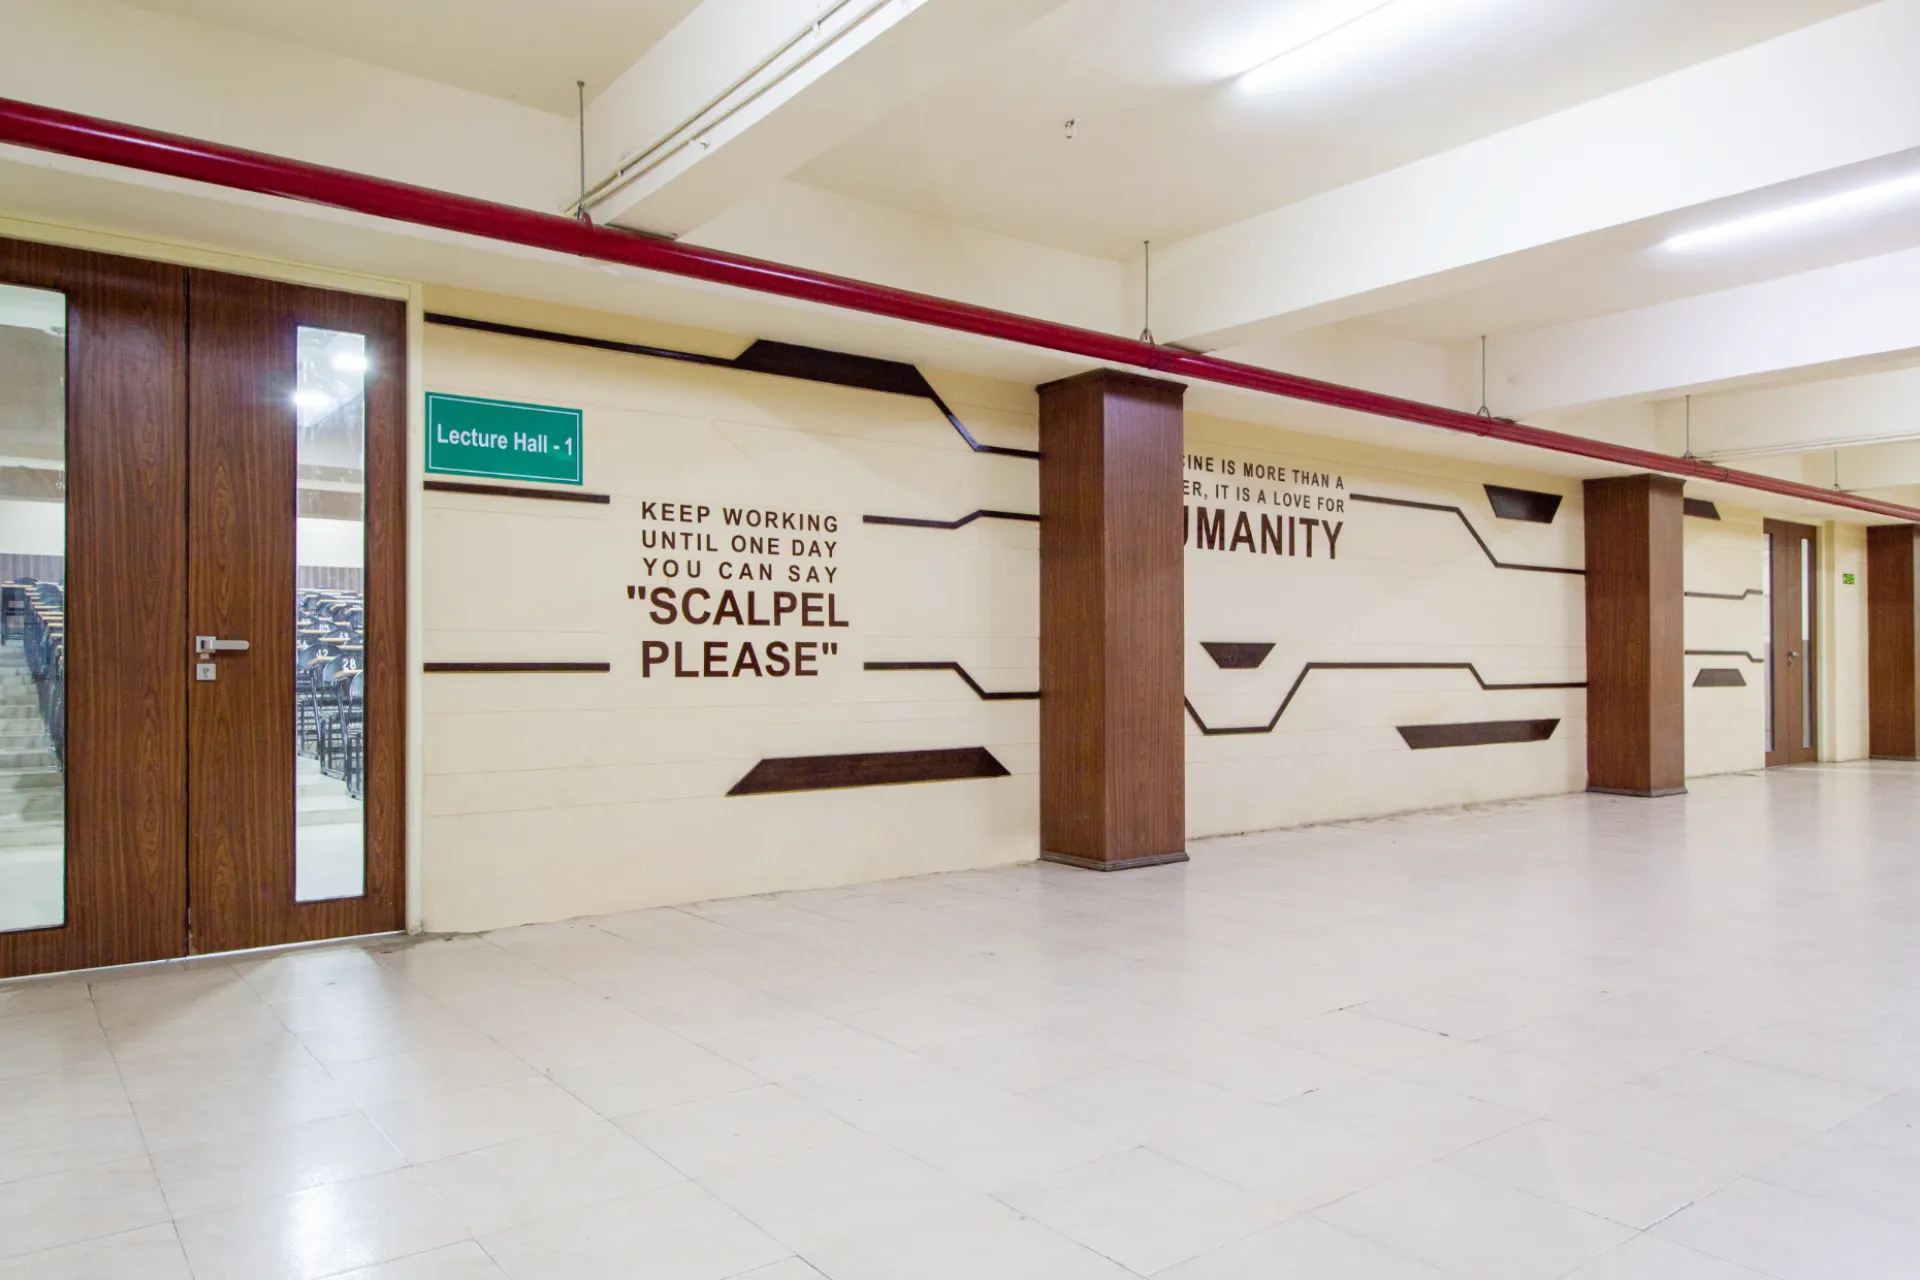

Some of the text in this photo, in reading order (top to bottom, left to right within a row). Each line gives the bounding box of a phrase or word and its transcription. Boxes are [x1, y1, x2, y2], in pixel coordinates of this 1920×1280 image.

[436, 423, 508, 450] Lecture
[513, 431, 548, 454] Hall
[564, 437, 573, 456] 1
[1221, 458, 1236, 476] IS
[1243, 462, 1286, 482] MORE
[1291, 468, 1330, 488] THAN
[1335, 475, 1345, 490] A
[1215, 483, 1229, 500] IT
[1236, 486, 1251, 503] IS
[1257, 489, 1267, 504] A
[1273, 490, 1311, 510] LOVE
[1317, 496, 1345, 514] FOR
[641, 501, 838, 533] KEEP WORKING
[642, 529, 837, 559] UNTIL ONE DAY
[642, 557, 837, 584] YOU CAN SAY
[627, 585, 849, 628] "SCALPEL
[342, 658, 357, 670] 28
[641, 640, 838, 679] PLEASE"
